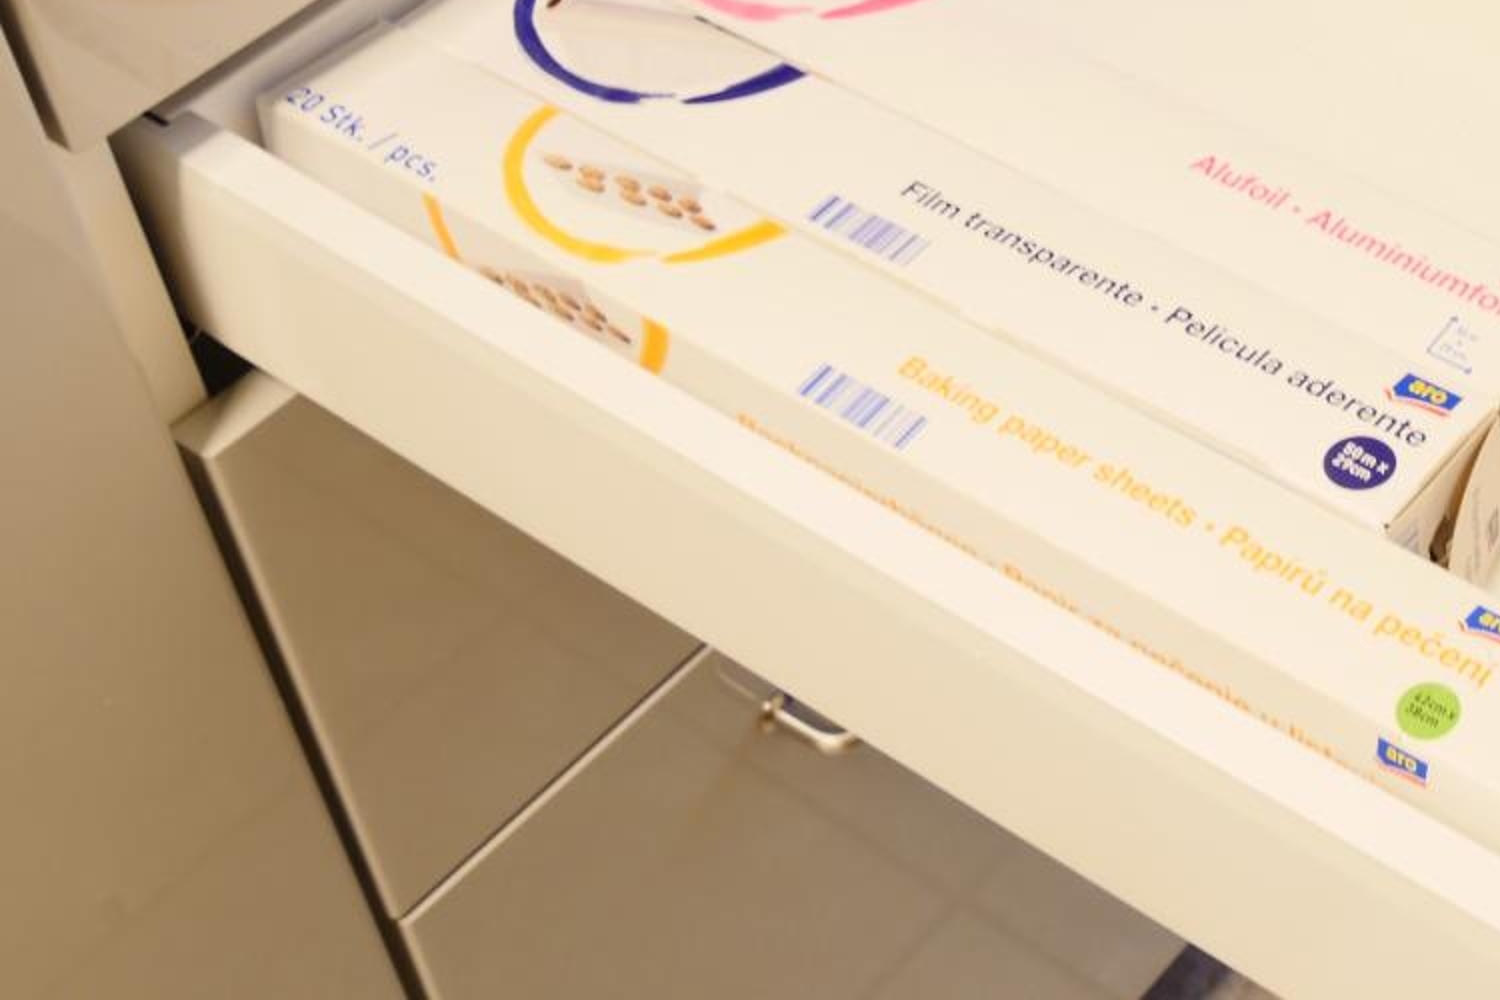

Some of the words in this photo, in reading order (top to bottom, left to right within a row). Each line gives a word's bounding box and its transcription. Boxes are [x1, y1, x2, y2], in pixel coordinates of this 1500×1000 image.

[383, 145, 437, 182] pcs.
[1190, 155, 1290, 209] Alufoil
[900, 180, 961, 219] Film
[964, 212, 1144, 307] transparente
[1286, 371, 1428, 447] aderente
[897, 356, 1000, 424] Baking
[997, 415, 1090, 468] paper
[1093, 463, 1196, 527] sheets
[1328, 587, 1374, 623] na
